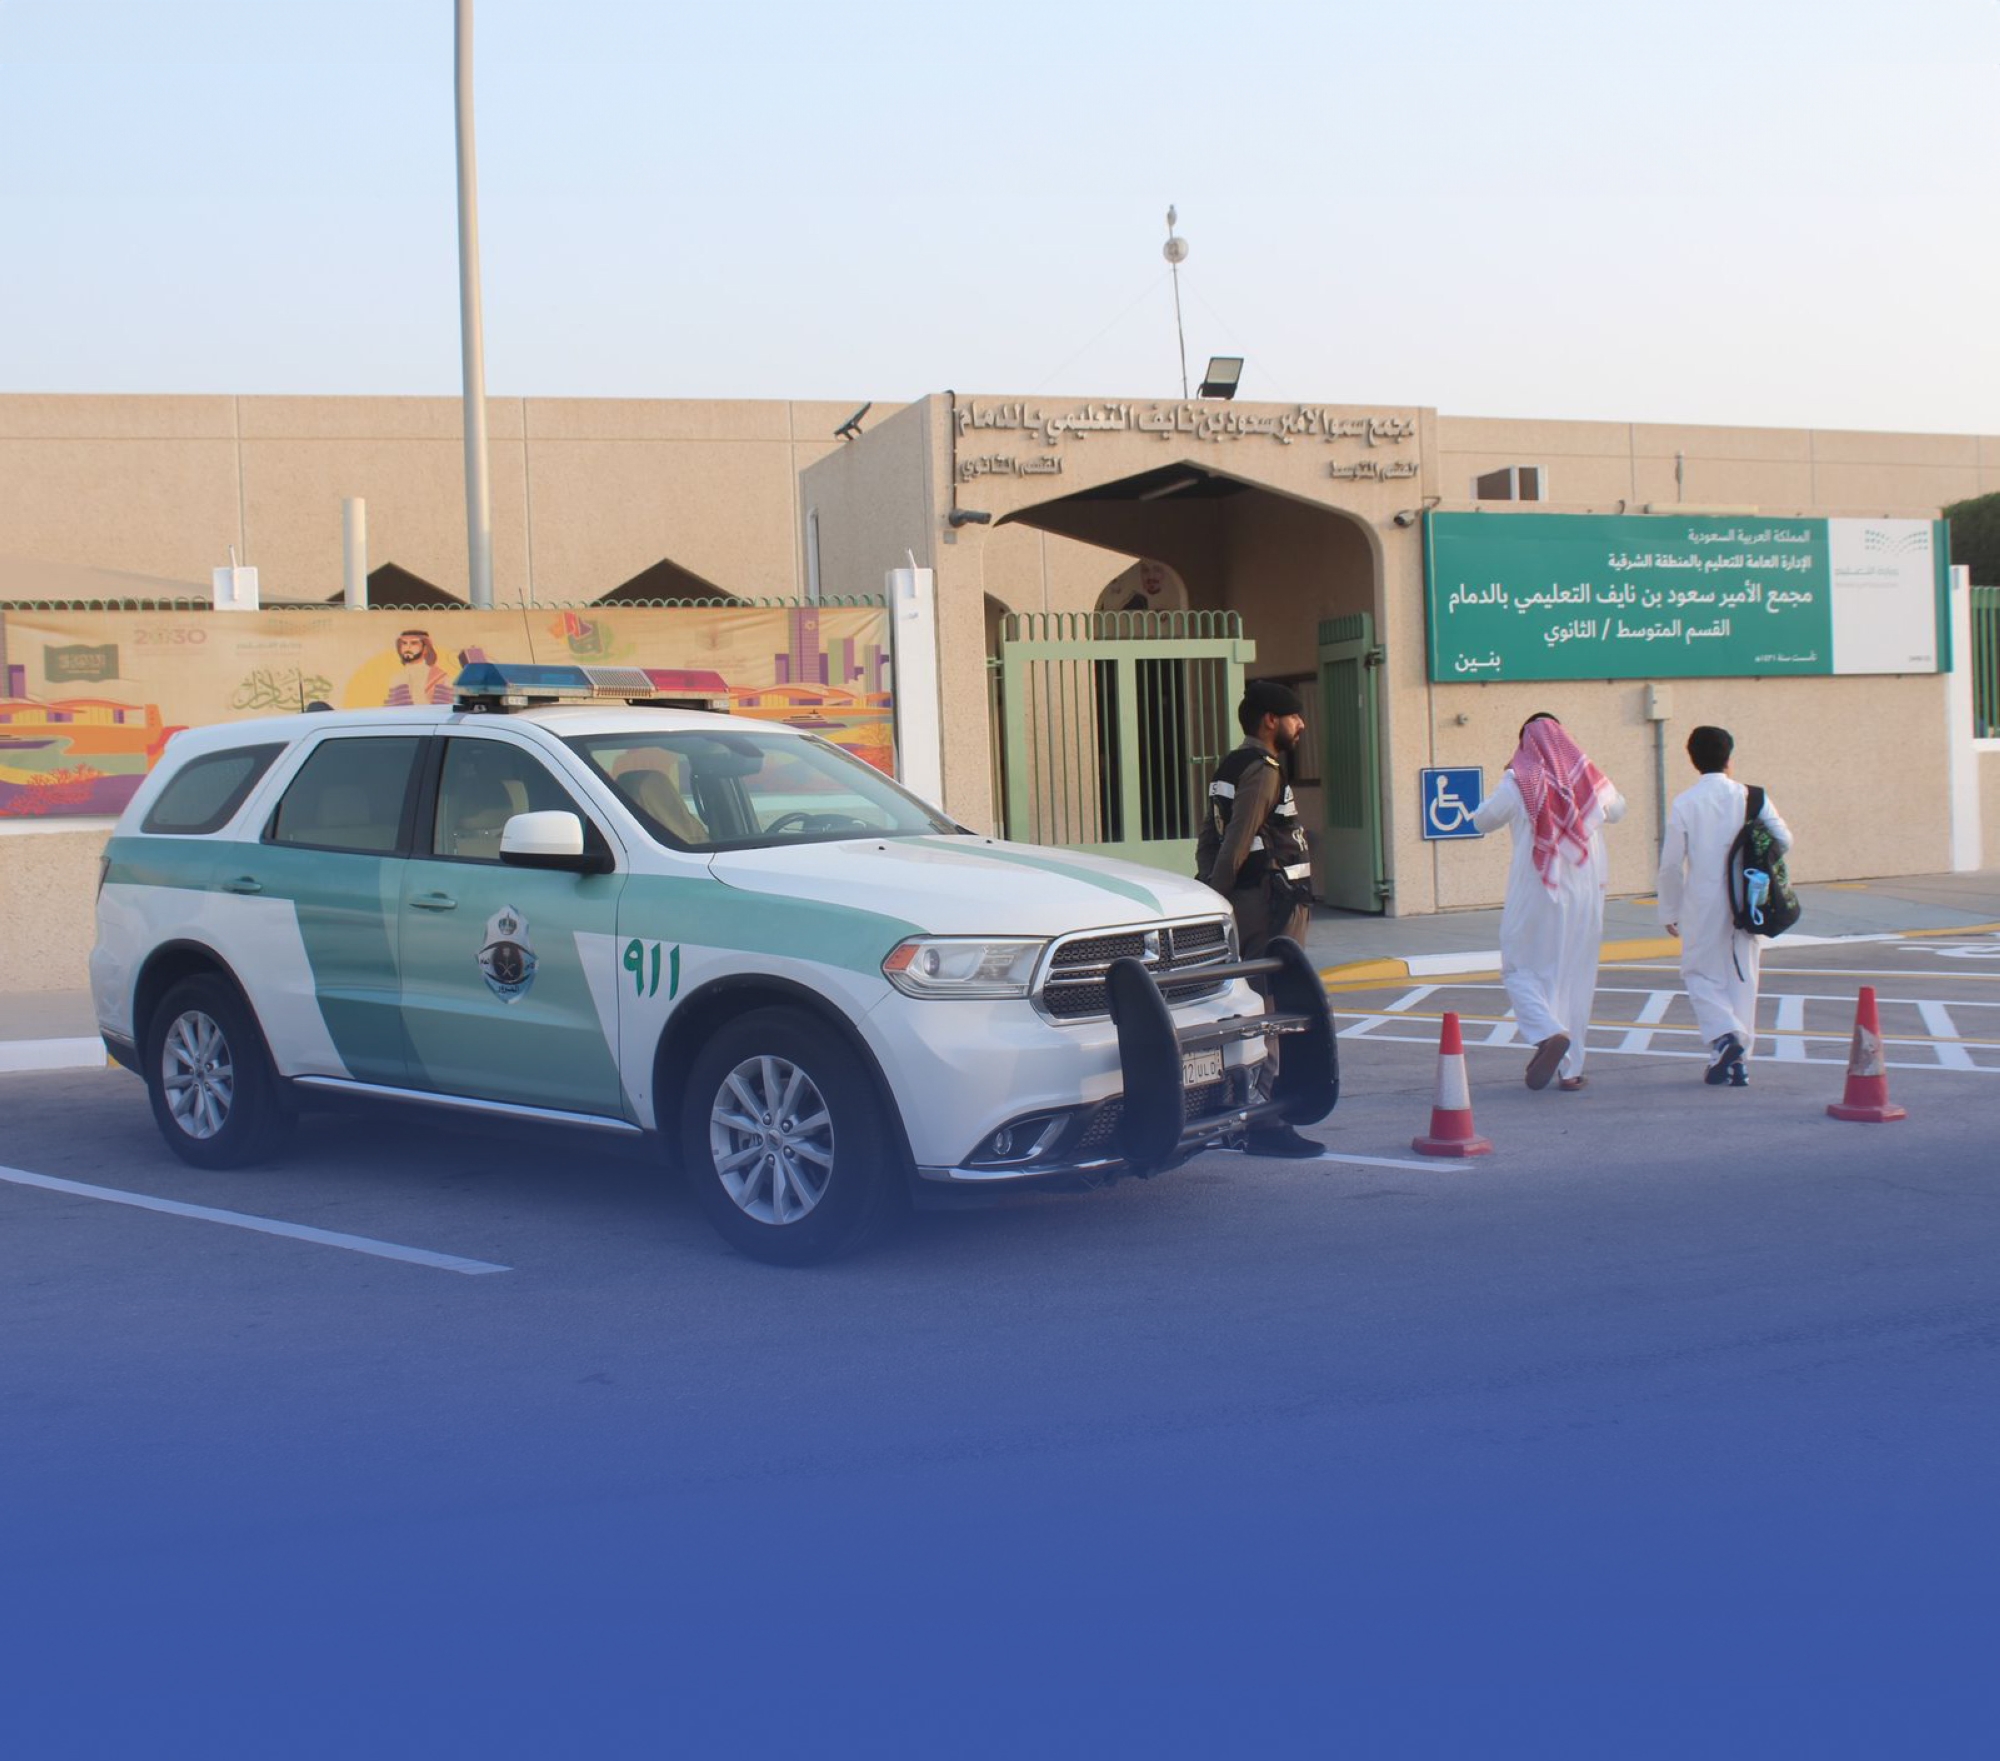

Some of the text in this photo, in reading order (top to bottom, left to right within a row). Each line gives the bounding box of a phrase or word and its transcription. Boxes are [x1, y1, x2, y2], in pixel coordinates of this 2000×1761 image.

[958, 402, 1045, 439] بالدمام
[1046, 403, 1135, 446] التعليمي
[1138, 403, 1196, 440] نايف
[1198, 406, 1224, 443] بن
[1225, 409, 1277, 440] سعود
[1325, 418, 1366, 444] سمو
[1368, 417, 1415, 447] مجمع
[959, 453, 1064, 483] القسم الثانوي
[1687, 528, 1811, 545] المملكة العربية السعودية
[1608, 553, 1653, 571] الشرقية
[1655, 553, 1703, 572] بالمنطقة
[1704, 553, 1744, 574] للتعليم
[1746, 554, 1779, 569] العامة
[1781, 554, 1812, 573] الإدارة
[1448, 579, 1814, 615] مجمع الأمير سعود بن نايف التعليمي بالدمام
[1543, 617, 1731, 648] القسم المتوسط / الثانوي
[1454, 651, 1501, 673] بنين
